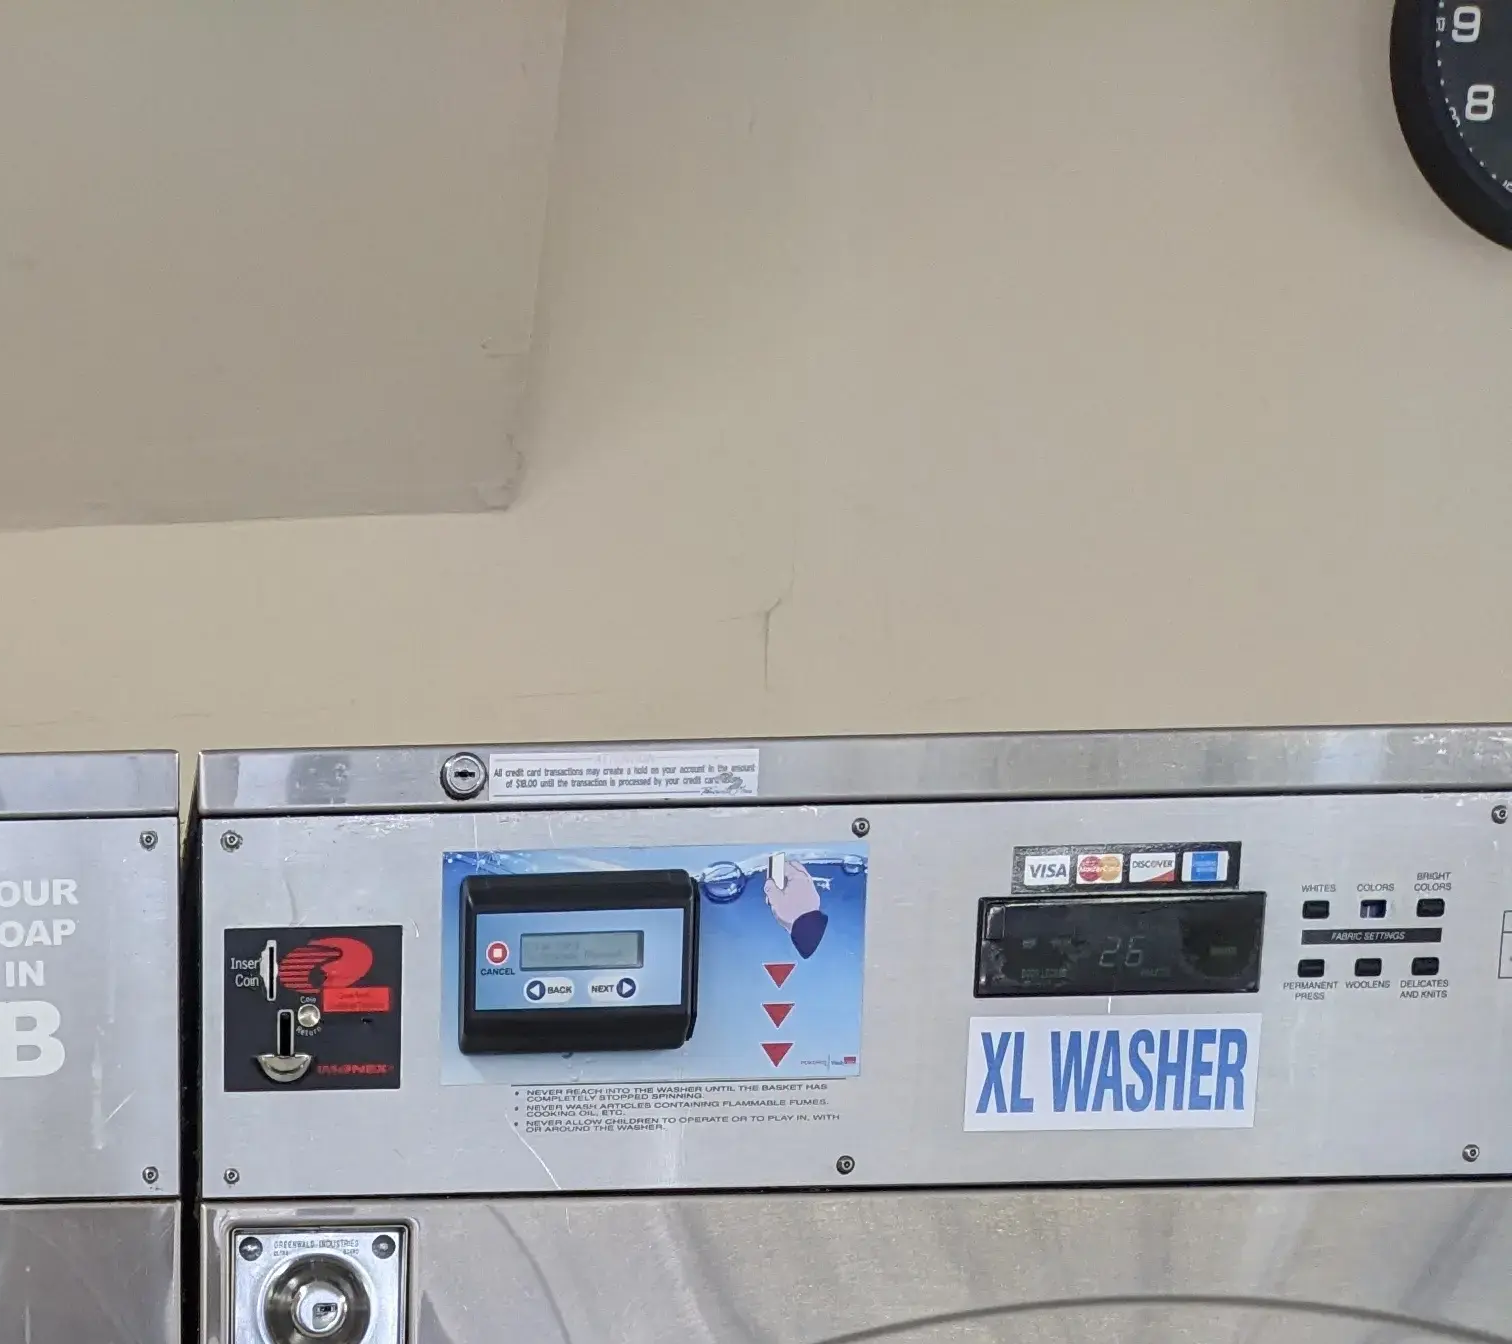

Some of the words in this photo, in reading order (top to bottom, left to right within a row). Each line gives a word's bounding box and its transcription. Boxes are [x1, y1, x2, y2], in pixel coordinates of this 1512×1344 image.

[1452, 6, 1481, 43] 9
[1465, 84, 1495, 121] 8
[1132, 859, 1174, 869] DISCOVER
[1029, 862, 1068, 879] VISA
[1416, 872, 1452, 881] BRIGHT
[1301, 884, 1336, 893] WHITES
[1356, 883, 1395, 892] COLORS
[1414, 882, 1452, 892] COLORS
[1331, 932, 1362, 941] FABRIC
[1363, 931, 1406, 940] SETTINGS
[230, 957, 262, 970] Inser
[5, 960, 45, 987] IN
[480, 967, 515, 976] CANCEL
[235, 974, 259, 987] Coin
[1345, 980, 1391, 989] WOOLENS
[1400, 979, 1449, 988] DELICATES
[547, 985, 572, 994] BACK
[591, 985, 614, 993] NEXT
[1283, 981, 1339, 990] PERMANENT
[1294, 991, 1325, 1000] PRESS
[1400, 990, 1419, 998] AND
[1421, 990, 1448, 998] KNITS
[976, 1031, 1034, 1113] XL
[1050, 1029, 1248, 1112] WASHER
